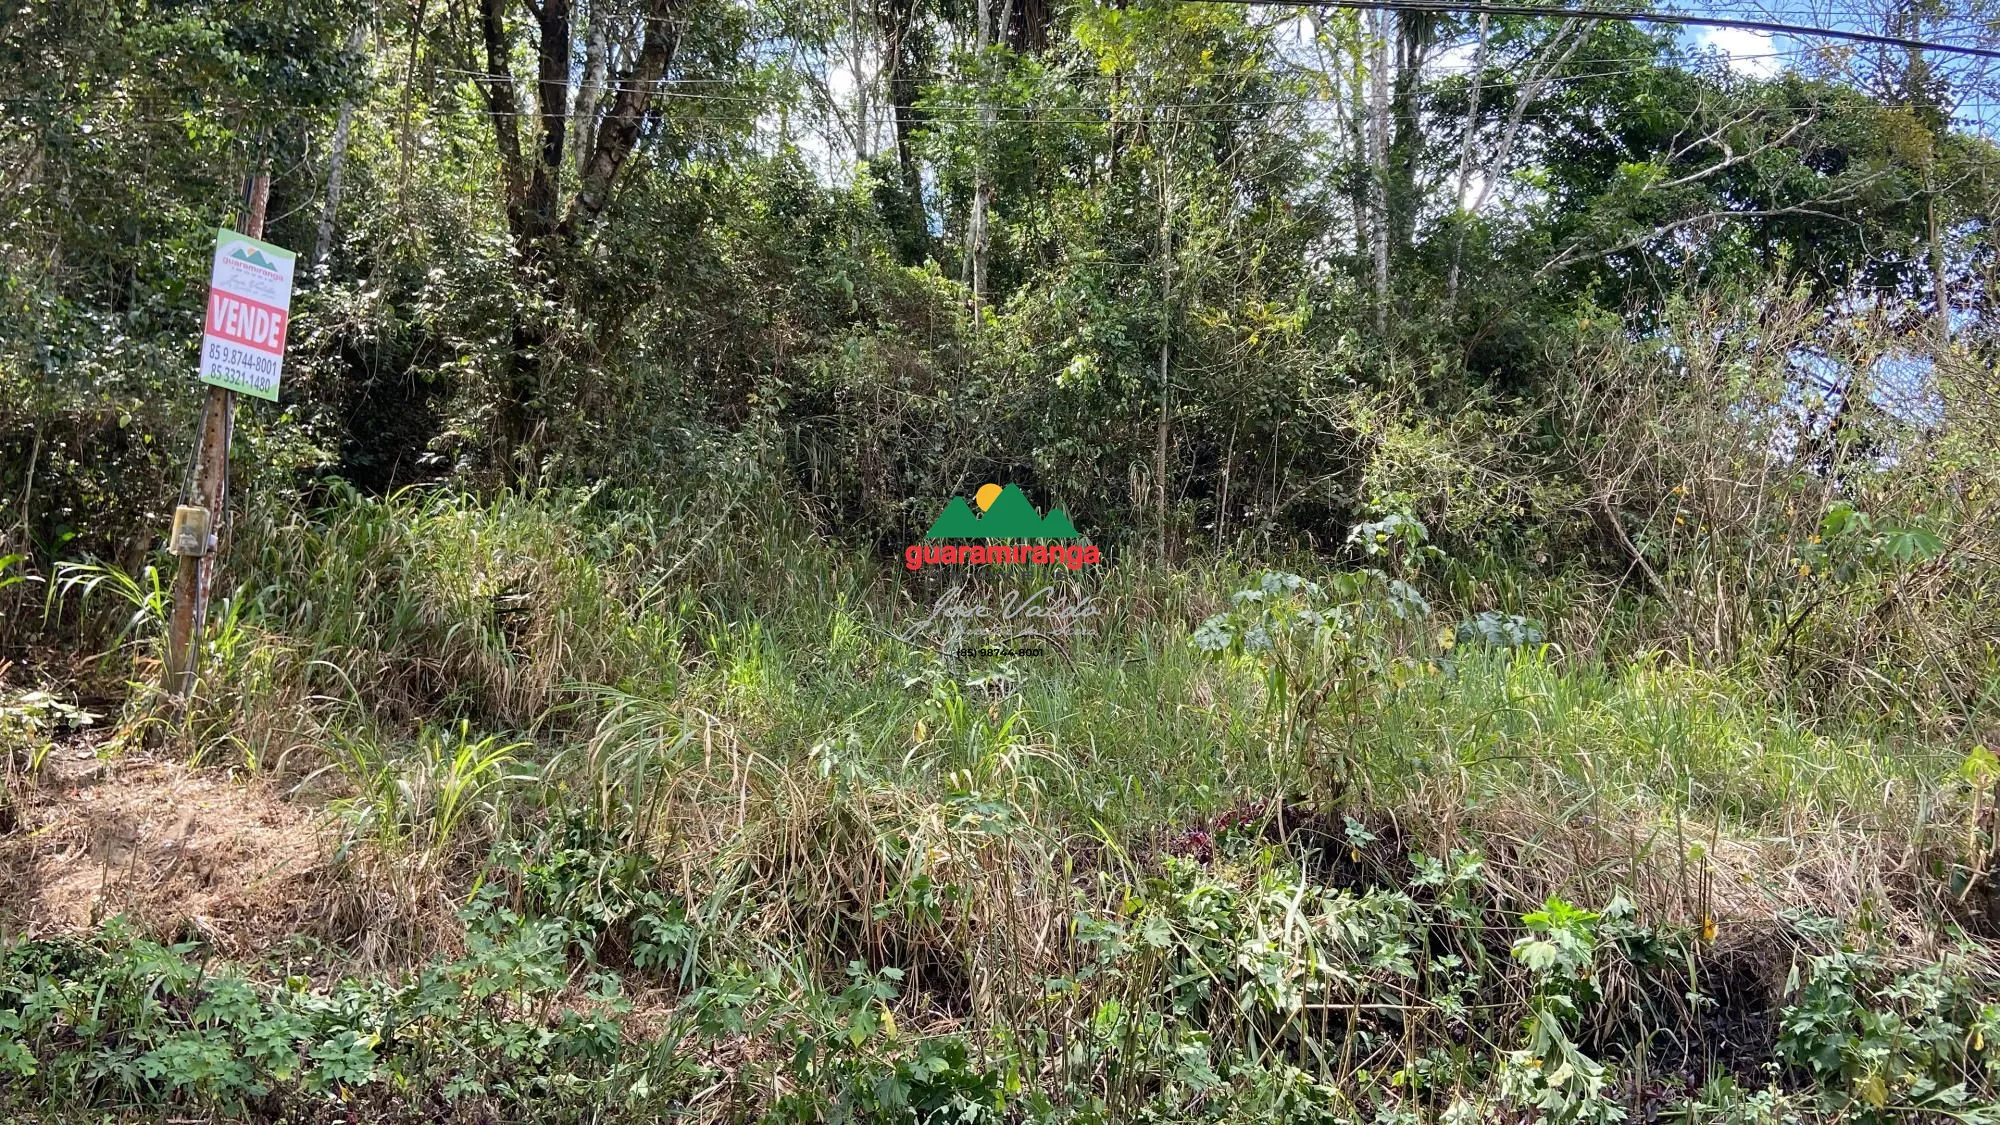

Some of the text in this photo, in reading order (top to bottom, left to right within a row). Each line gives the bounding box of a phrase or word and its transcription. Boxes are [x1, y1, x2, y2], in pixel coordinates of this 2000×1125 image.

[223, 256, 284, 282] guaramiranga
[212, 294, 282, 348] VENDE
[209, 343, 277, 376] 85 9.8744-8001
[210, 363, 271, 393] 85 3321-1480
